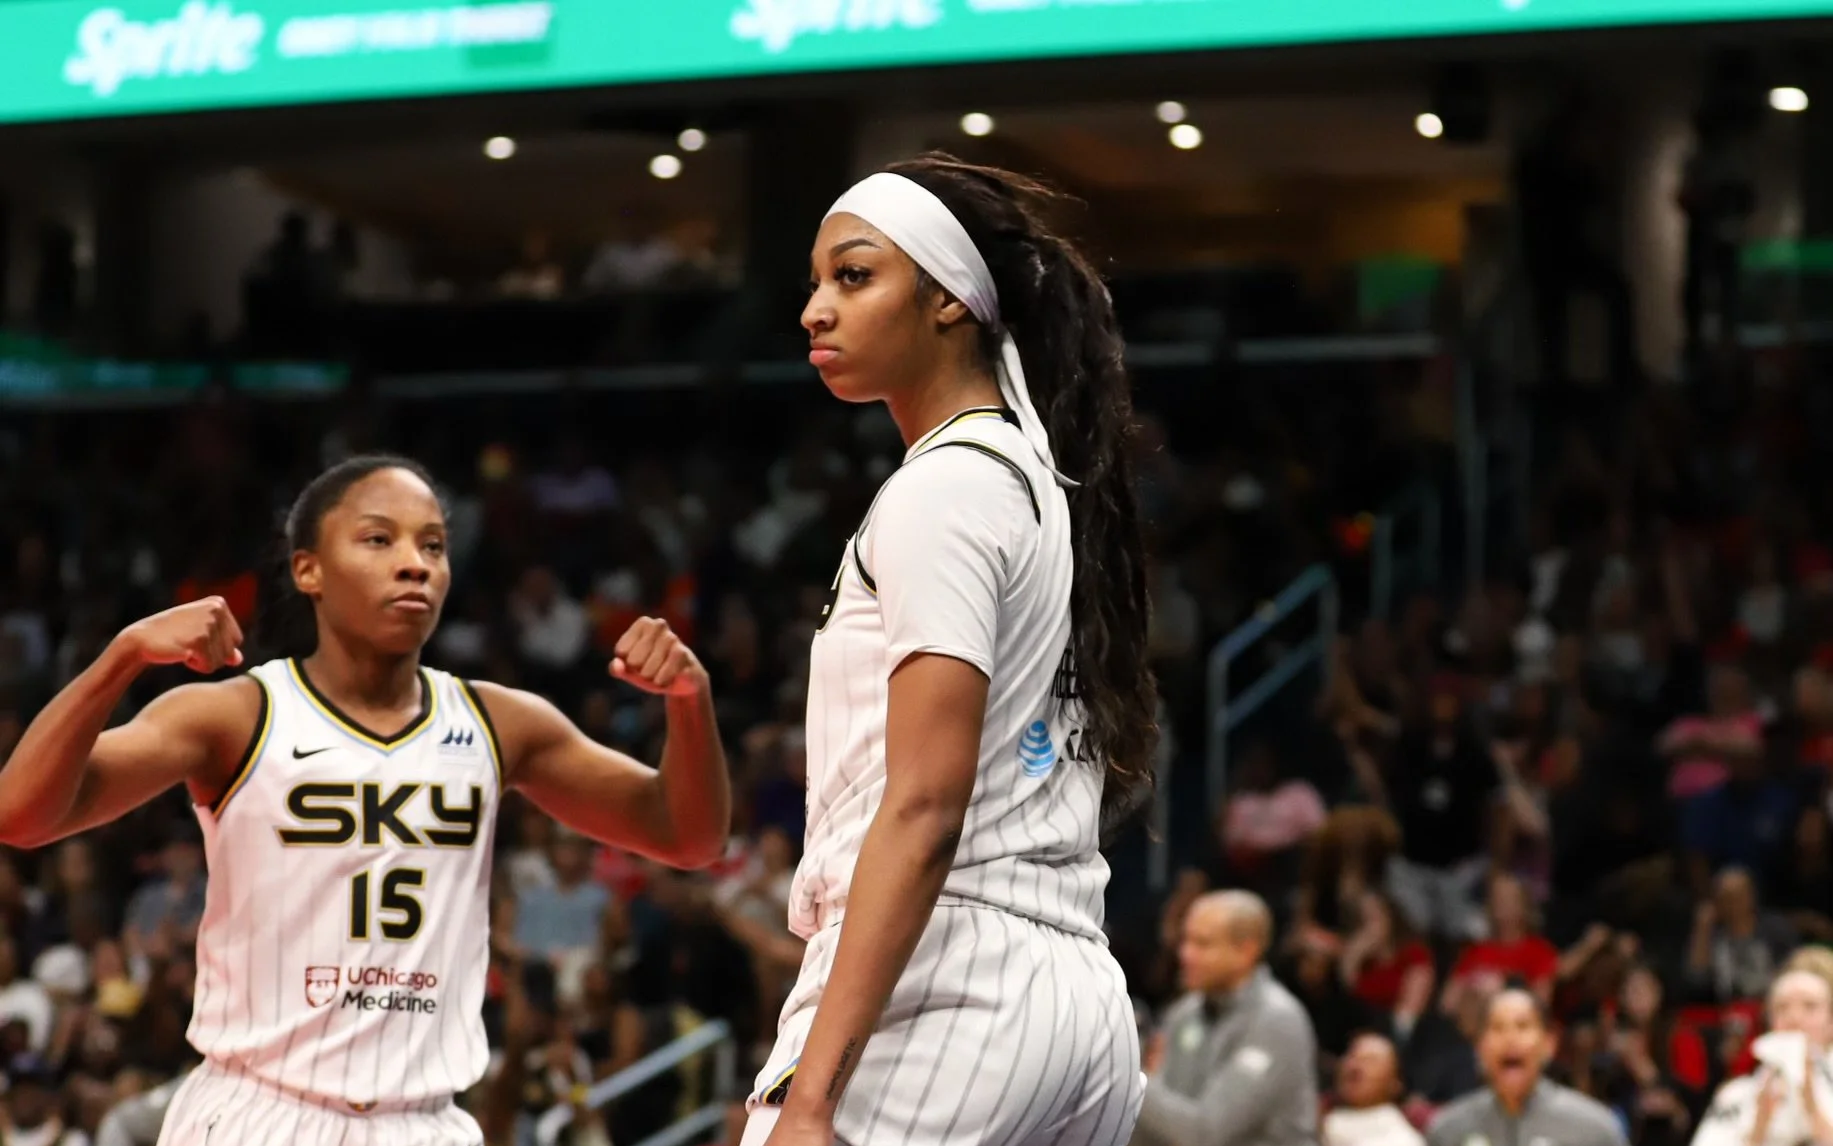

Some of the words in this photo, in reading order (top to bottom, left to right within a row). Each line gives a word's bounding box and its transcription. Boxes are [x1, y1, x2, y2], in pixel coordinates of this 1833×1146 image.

[61, 0, 265, 98] Sprite
[275, 781, 483, 849] SKY
[348, 868, 427, 942] 15
[341, 989, 437, 1014] Medicine
[347, 966, 438, 991] UChicago
